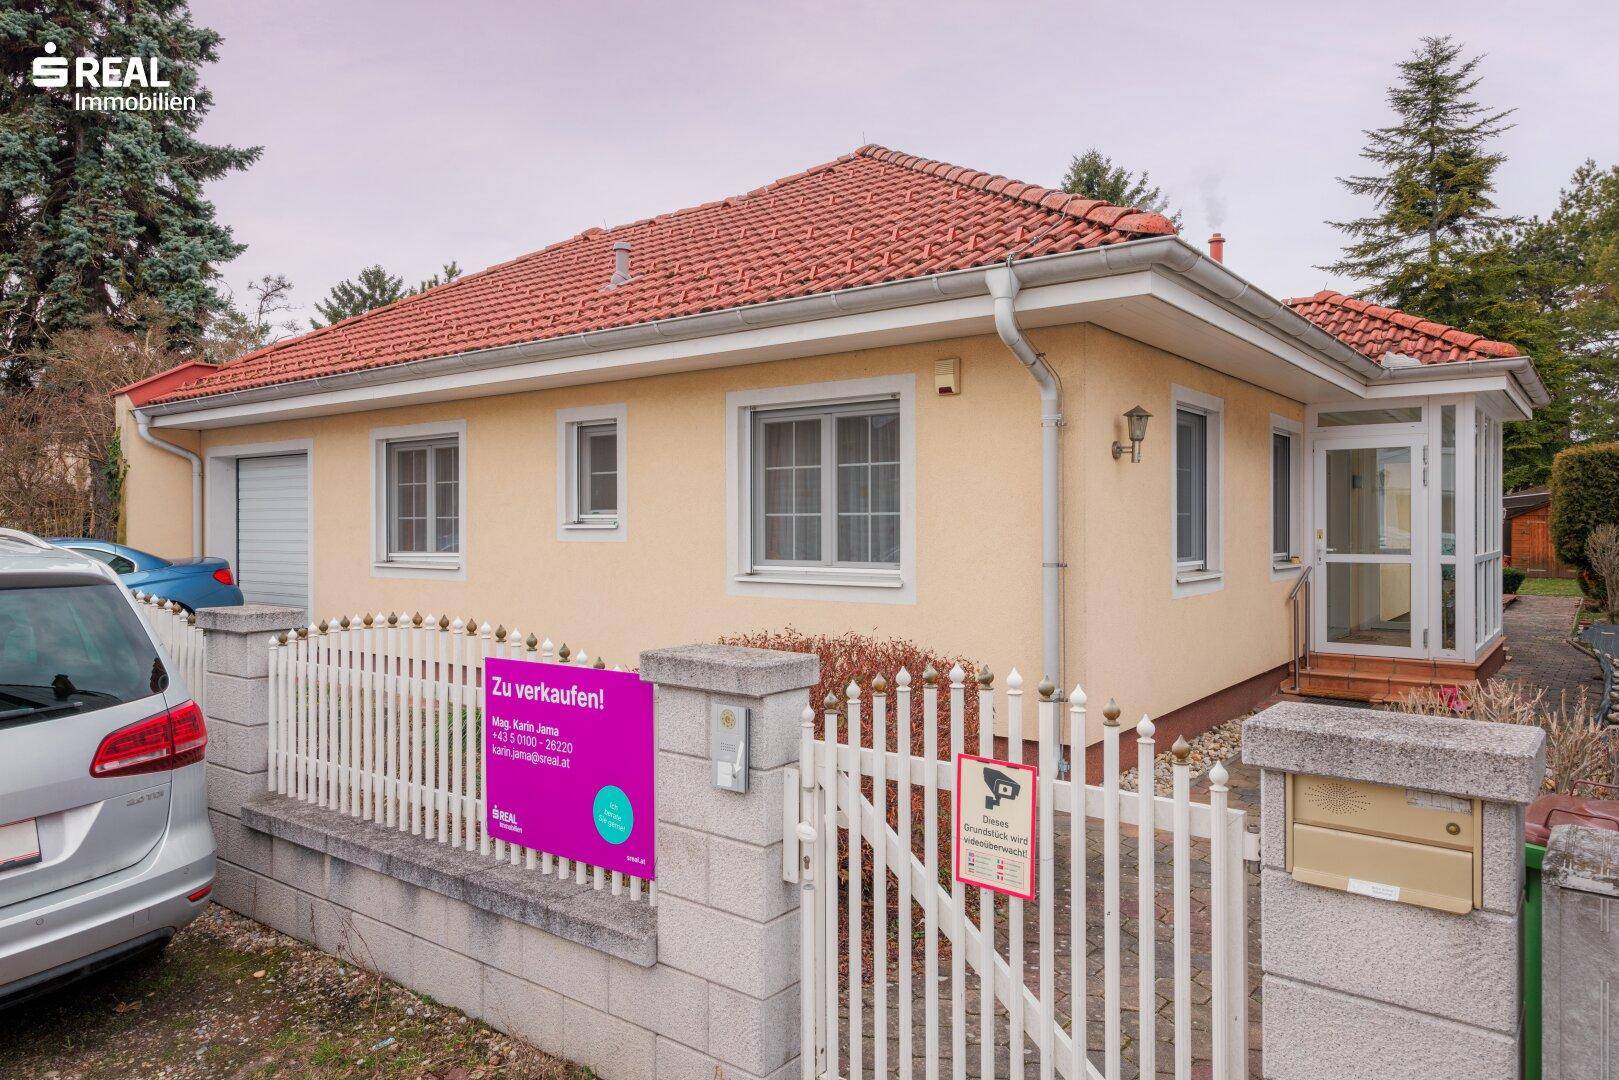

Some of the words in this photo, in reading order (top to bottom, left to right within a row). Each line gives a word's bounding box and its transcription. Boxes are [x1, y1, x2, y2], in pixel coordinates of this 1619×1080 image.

[491, 676, 513, 698] Zu
[515, 682, 605, 710] verkaufen!
[491, 716, 512, 731] Mag.
[512, 719, 535, 733] Karin
[536, 723, 560, 737] Jama
[492, 731, 508, 743] +43
[509, 733, 516, 744] 5
[516, 734, 537, 748] 0100
[545, 738, 573, 754] 26220
[491, 744, 571, 769] karin.jama@sreal.at
[499, 810, 518, 825] REAL
[598, 814, 608, 824] Sie
[607, 820, 626, 833] gerne!
[603, 809, 622, 823] berate
[982, 815, 1009, 829] Dieses
[499, 822, 523, 834] Immobilien
[963, 823, 1009, 841] Grundstück
[1010, 834, 1029, 846] wird
[963, 836, 1029, 859] videoüberwacht!
[626, 854, 646, 866] sreal.at
